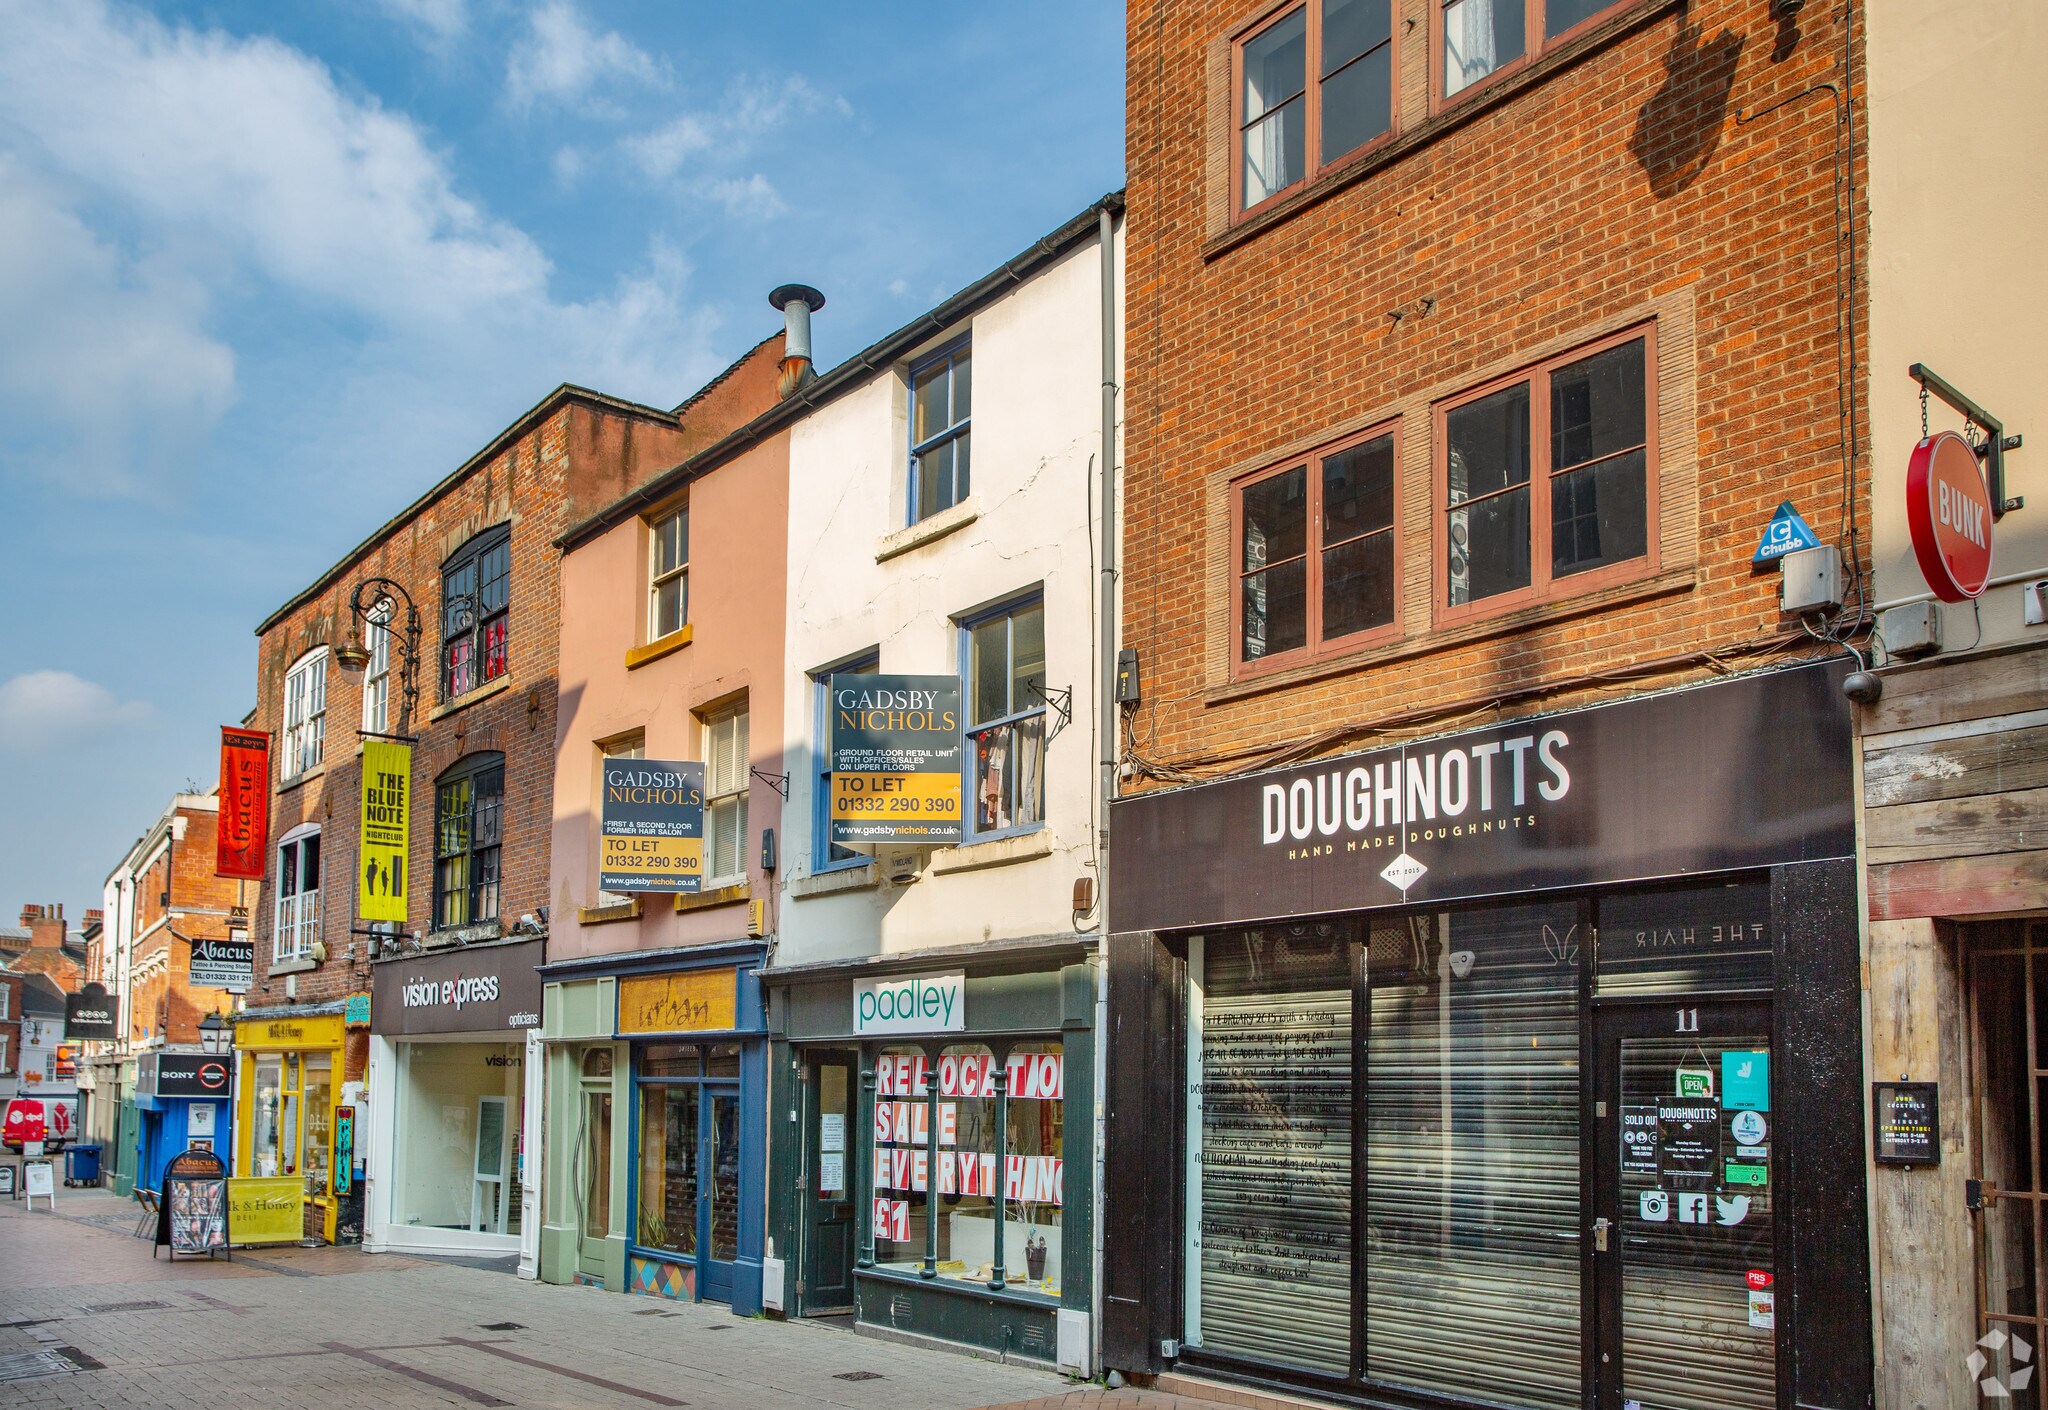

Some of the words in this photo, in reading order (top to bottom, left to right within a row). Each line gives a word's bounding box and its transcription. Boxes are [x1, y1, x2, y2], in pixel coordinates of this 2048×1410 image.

[1938, 479, 1986, 550] BUNK
[1761, 537, 1803, 556] Chubb
[839, 689, 939, 710] GADSBY
[840, 711, 955, 731] NICHOLS
[839, 749, 874, 757] GROUND
[863, 756, 924, 764] OFFICES/SALES
[377, 772, 404, 791] THE
[609, 771, 688, 788] GADSBY
[839, 777, 864, 792] TO
[871, 778, 906, 792] LET
[1263, 730, 1570, 845] DOUGHNOTTS
[367, 788, 404, 807] BLUE
[609, 787, 700, 805] NICHOLS
[254, 792, 262, 831] piercing
[838, 798, 884, 812] 01332
[890, 798, 920, 812] 290
[925, 798, 955, 812] 390
[232, 760, 253, 868] Abacus
[366, 805, 404, 824] NOTE
[366, 830, 404, 842] NIGHTCLUB
[838, 825, 954, 836] www.gadsbynichols.co.uk
[1289, 845, 1333, 860] HAND
[1347, 836, 1395, 852] MADE
[1411, 815, 1536, 843] DOUGHNUTS
[607, 840, 626, 851] TO
[632, 841, 659, 851] LET
[606, 855, 642, 866] 01332
[647, 856, 669, 867] 290
[674, 857, 697, 868] 390
[606, 877, 696, 886] www.gadsbynichols.co.uk
[192, 939, 253, 960] Abacus
[206, 973, 226, 981] 01332
[402, 976, 439, 1008] vision
[441, 972, 500, 1011] express
[860, 978, 957, 1030] padley
[508, 1012, 539, 1028] opticians
[1212, 1013, 1254, 1025] FEBRUARY
[1675, 1008, 1699, 1032] 11
[1257, 1034, 1273, 1045] way
[1284, 1033, 1310, 1045] paying
[485, 1054, 521, 1067] vision
[161, 1071, 196, 1079] SONY
[877, 1055, 1063, 1098] RELOCATIO
[1684, 1080, 1703, 1091] OPEN
[25, 1112, 43, 1122] dpd
[1624, 1115, 1644, 1125] SOLD
[1659, 1107, 1717, 1120] DOUGHNOTTS
[876, 1102, 956, 1144] SALE
[176, 1157, 218, 1166] Abacus
[228, 1200, 240, 1211] lk
[243, 1201, 252, 1211] &
[256, 1200, 297, 1213] Honey
[874, 1199, 909, 1241] £1
[1292, 1250, 1340, 1265] independent
[1749, 1272, 1766, 1282] PRS
